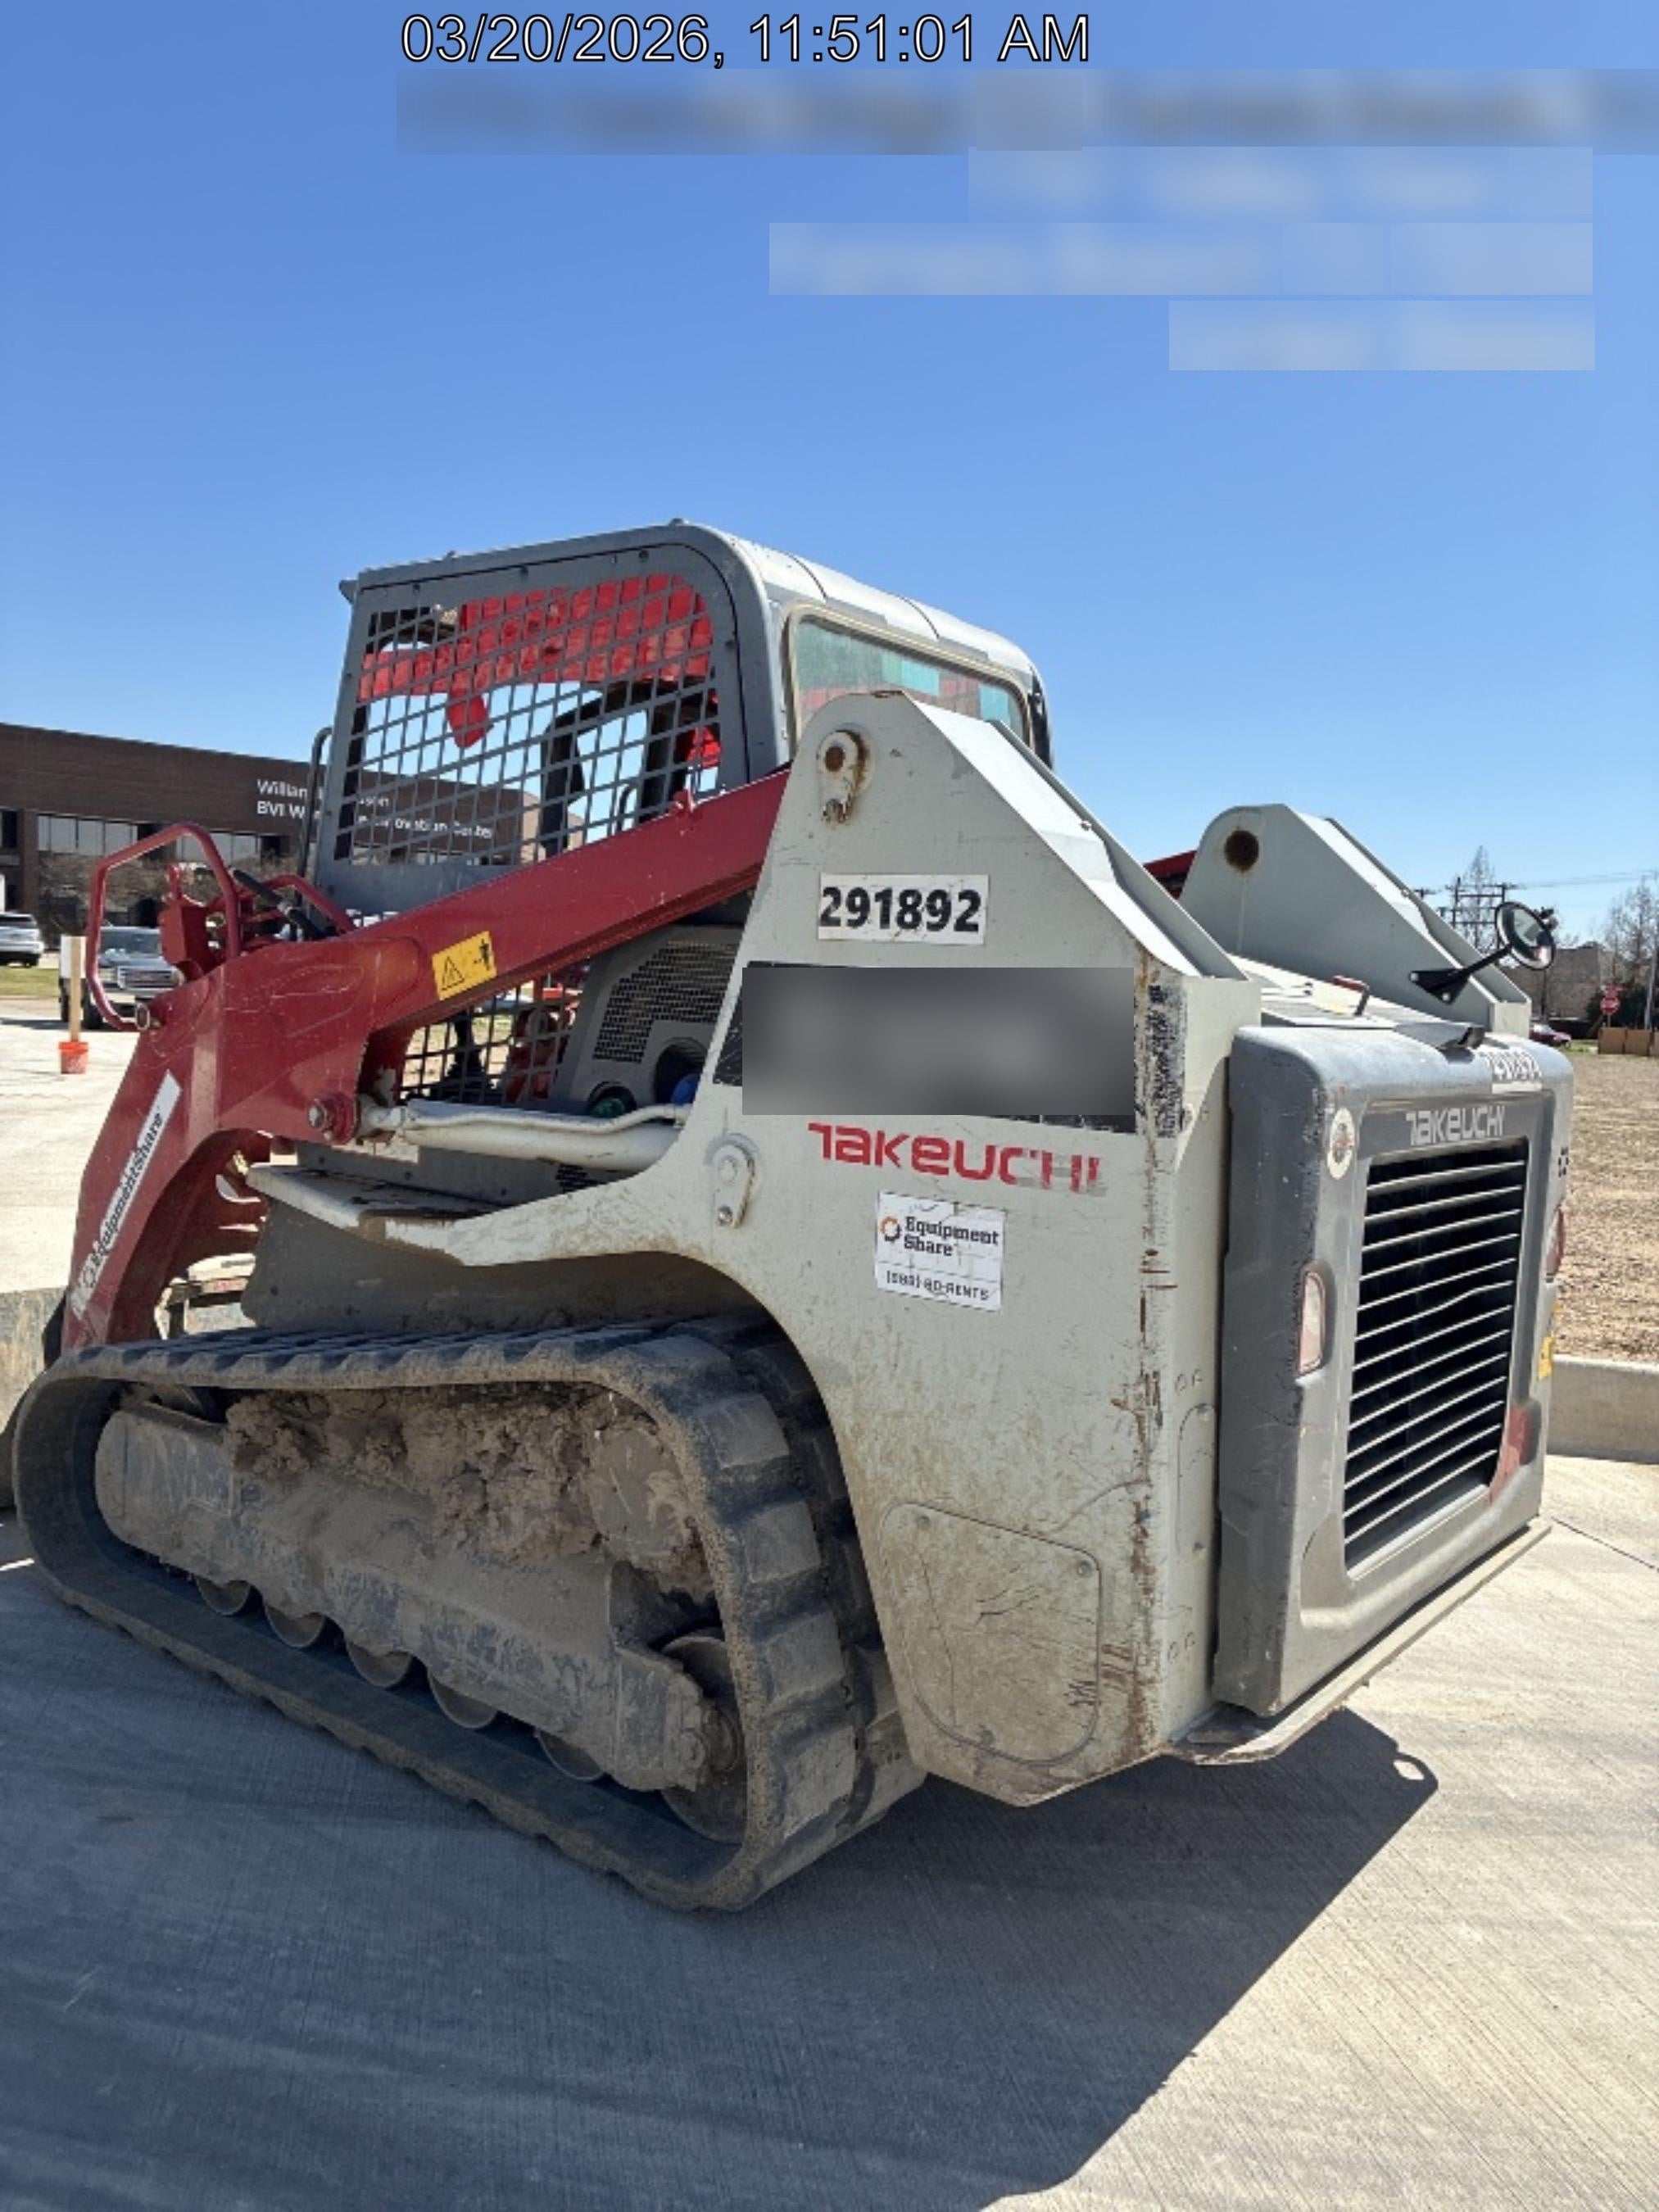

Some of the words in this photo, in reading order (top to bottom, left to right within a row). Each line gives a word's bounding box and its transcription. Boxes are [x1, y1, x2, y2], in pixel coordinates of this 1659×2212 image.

[819, 886, 981, 932] 291892
[904, 1216, 999, 1245] Equipment
[904, 1234, 953, 1257] Share
